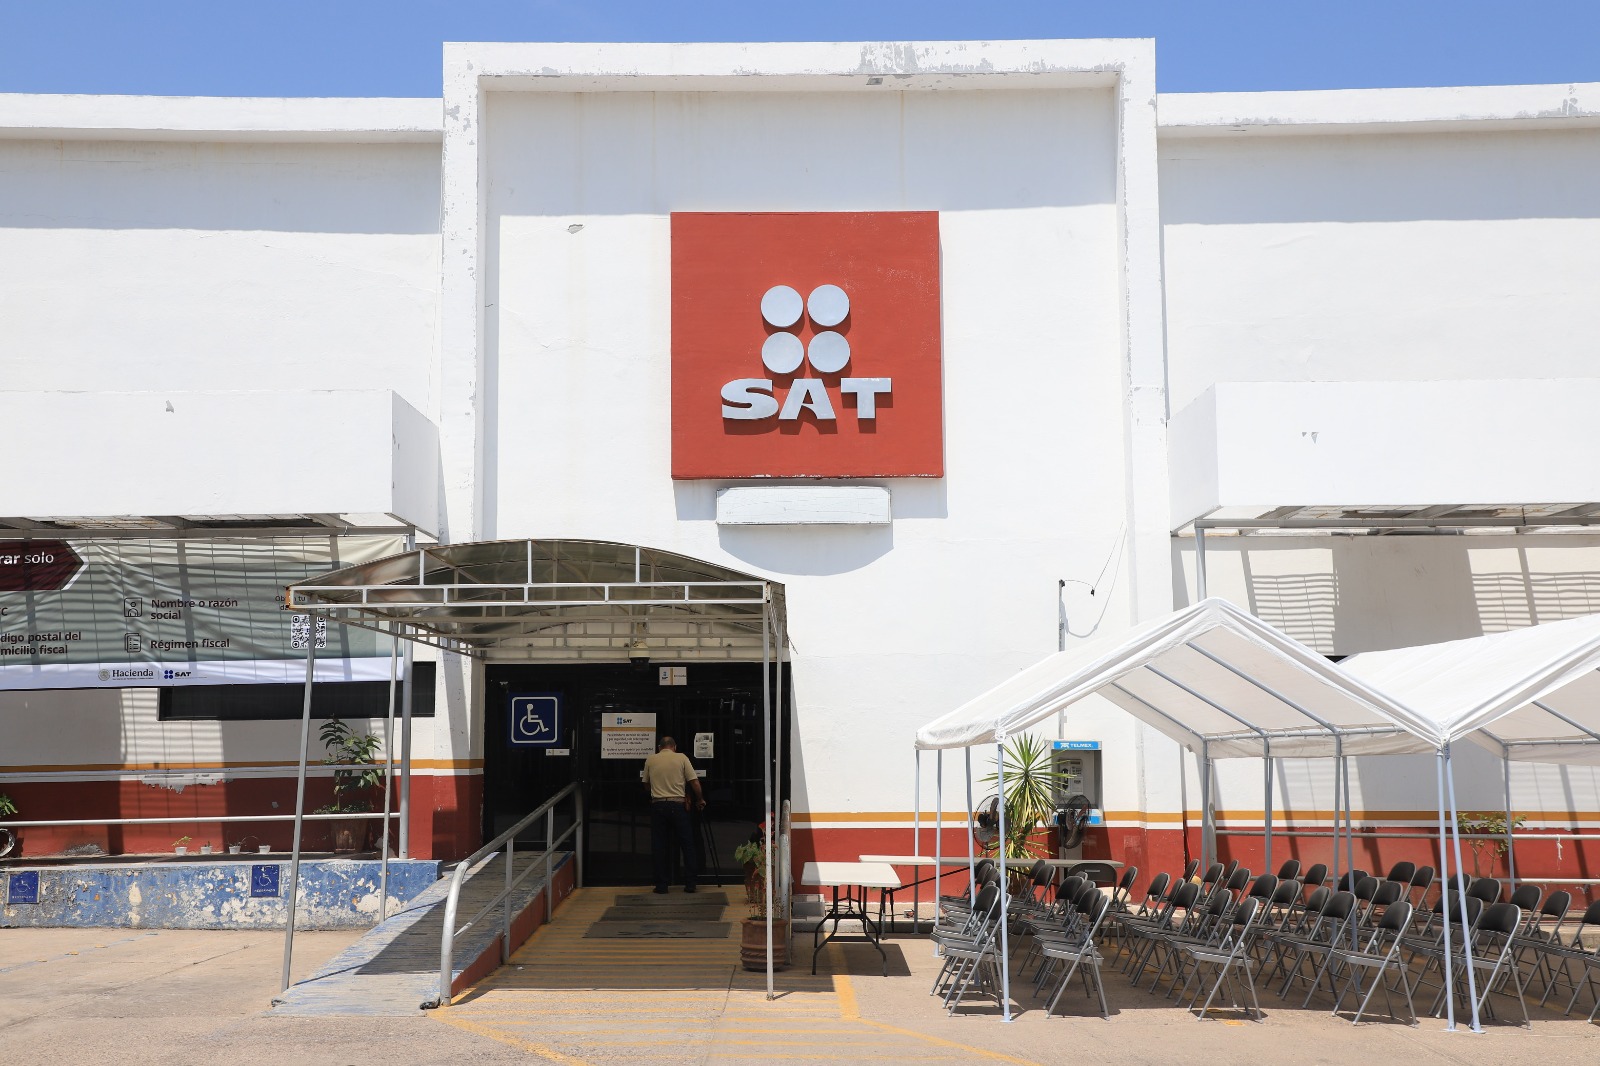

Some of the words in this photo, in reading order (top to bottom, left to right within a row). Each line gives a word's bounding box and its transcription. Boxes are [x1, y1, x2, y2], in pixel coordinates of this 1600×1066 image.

[720, 377, 892, 420] SAT
[24, 551, 54, 564] solo
[151, 599, 196, 608] Nombre
[198, 600, 205, 608] o
[208, 598, 238, 608] razón
[151, 610, 181, 620] social
[0, 632, 25, 645] digo
[28, 632, 62, 644] postal
[65, 632, 82, 641] del
[150, 639, 199, 651] Régimen
[202, 638, 230, 648] fiscal
[0, 645, 36, 656] micilio
[39, 645, 68, 655] fiscal
[112, 669, 154, 677] Hacienda
